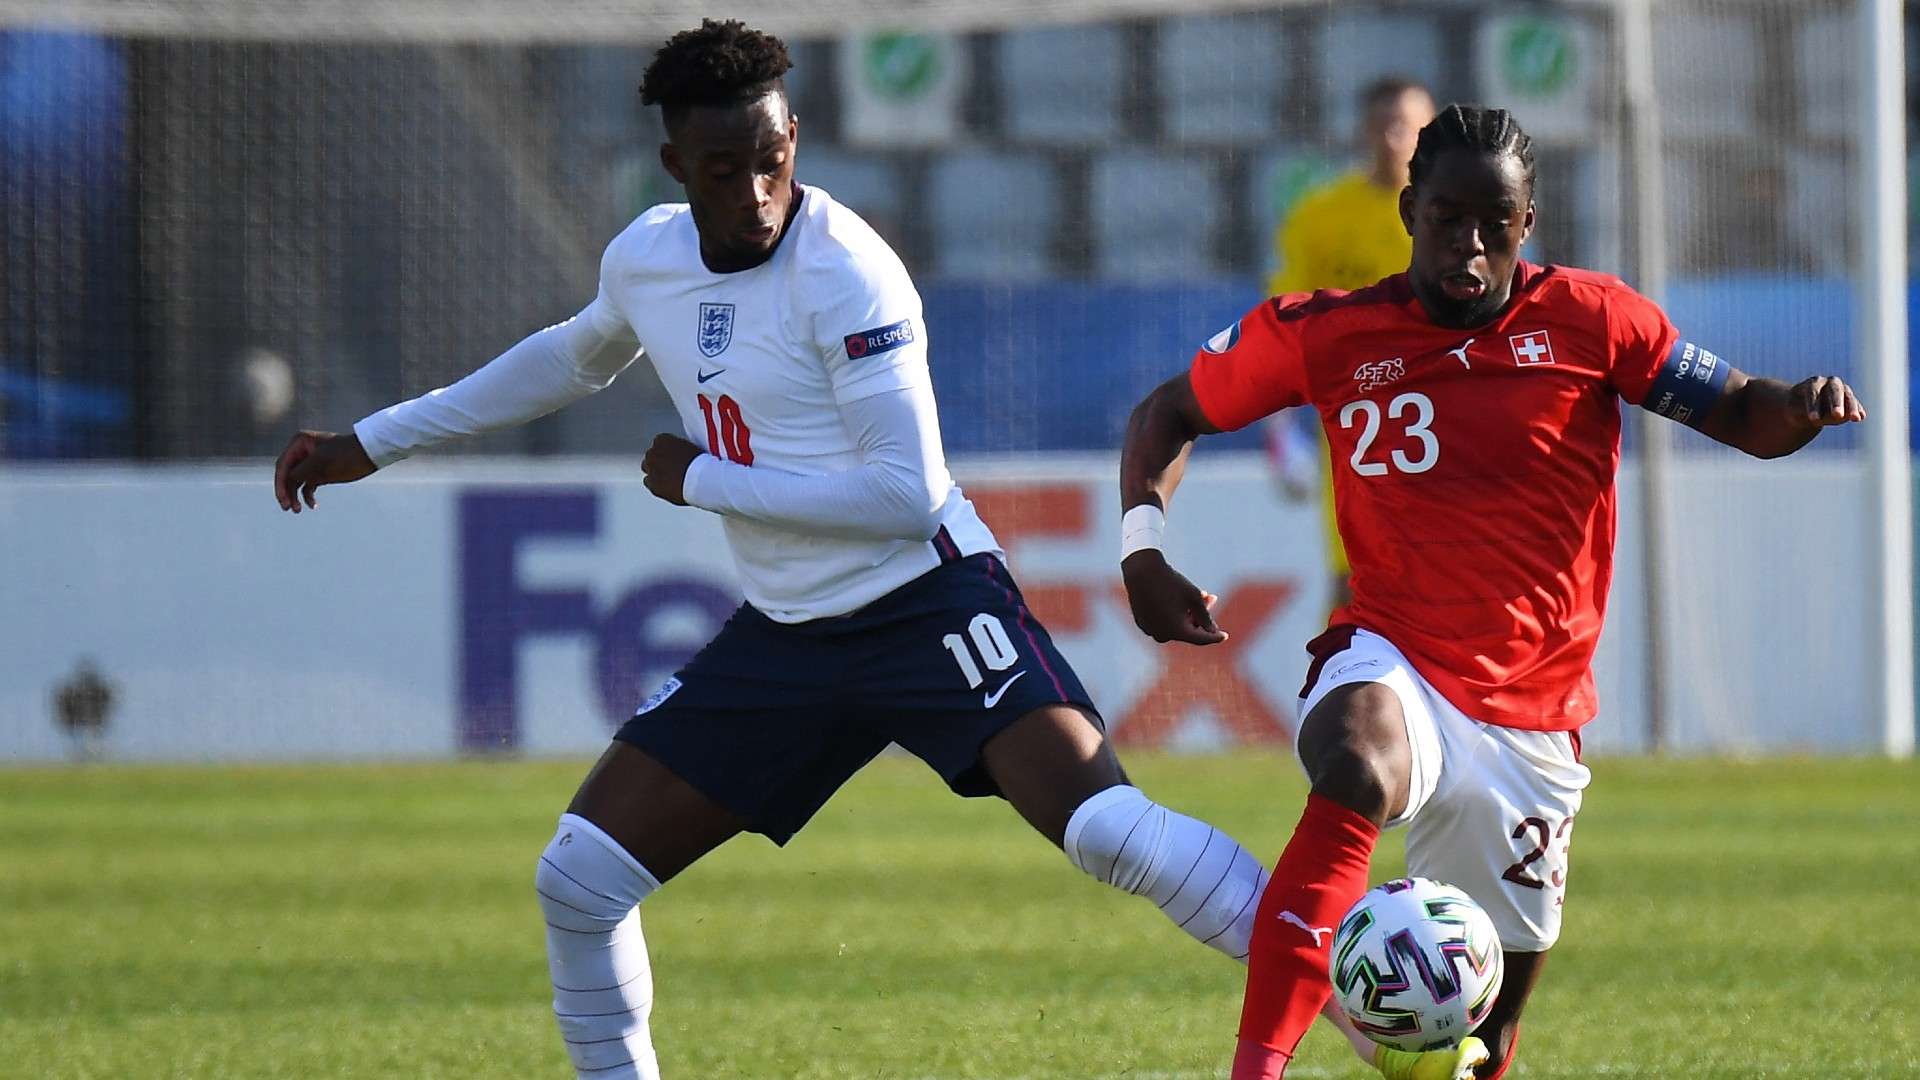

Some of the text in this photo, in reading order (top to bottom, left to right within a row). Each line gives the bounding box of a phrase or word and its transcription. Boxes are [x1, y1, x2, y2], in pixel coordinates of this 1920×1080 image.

[697, 393, 755, 468] 10
[1340, 392, 1440, 477] 23
[457, 487, 1295, 752] FeEx
[942, 612, 1020, 690] 10
